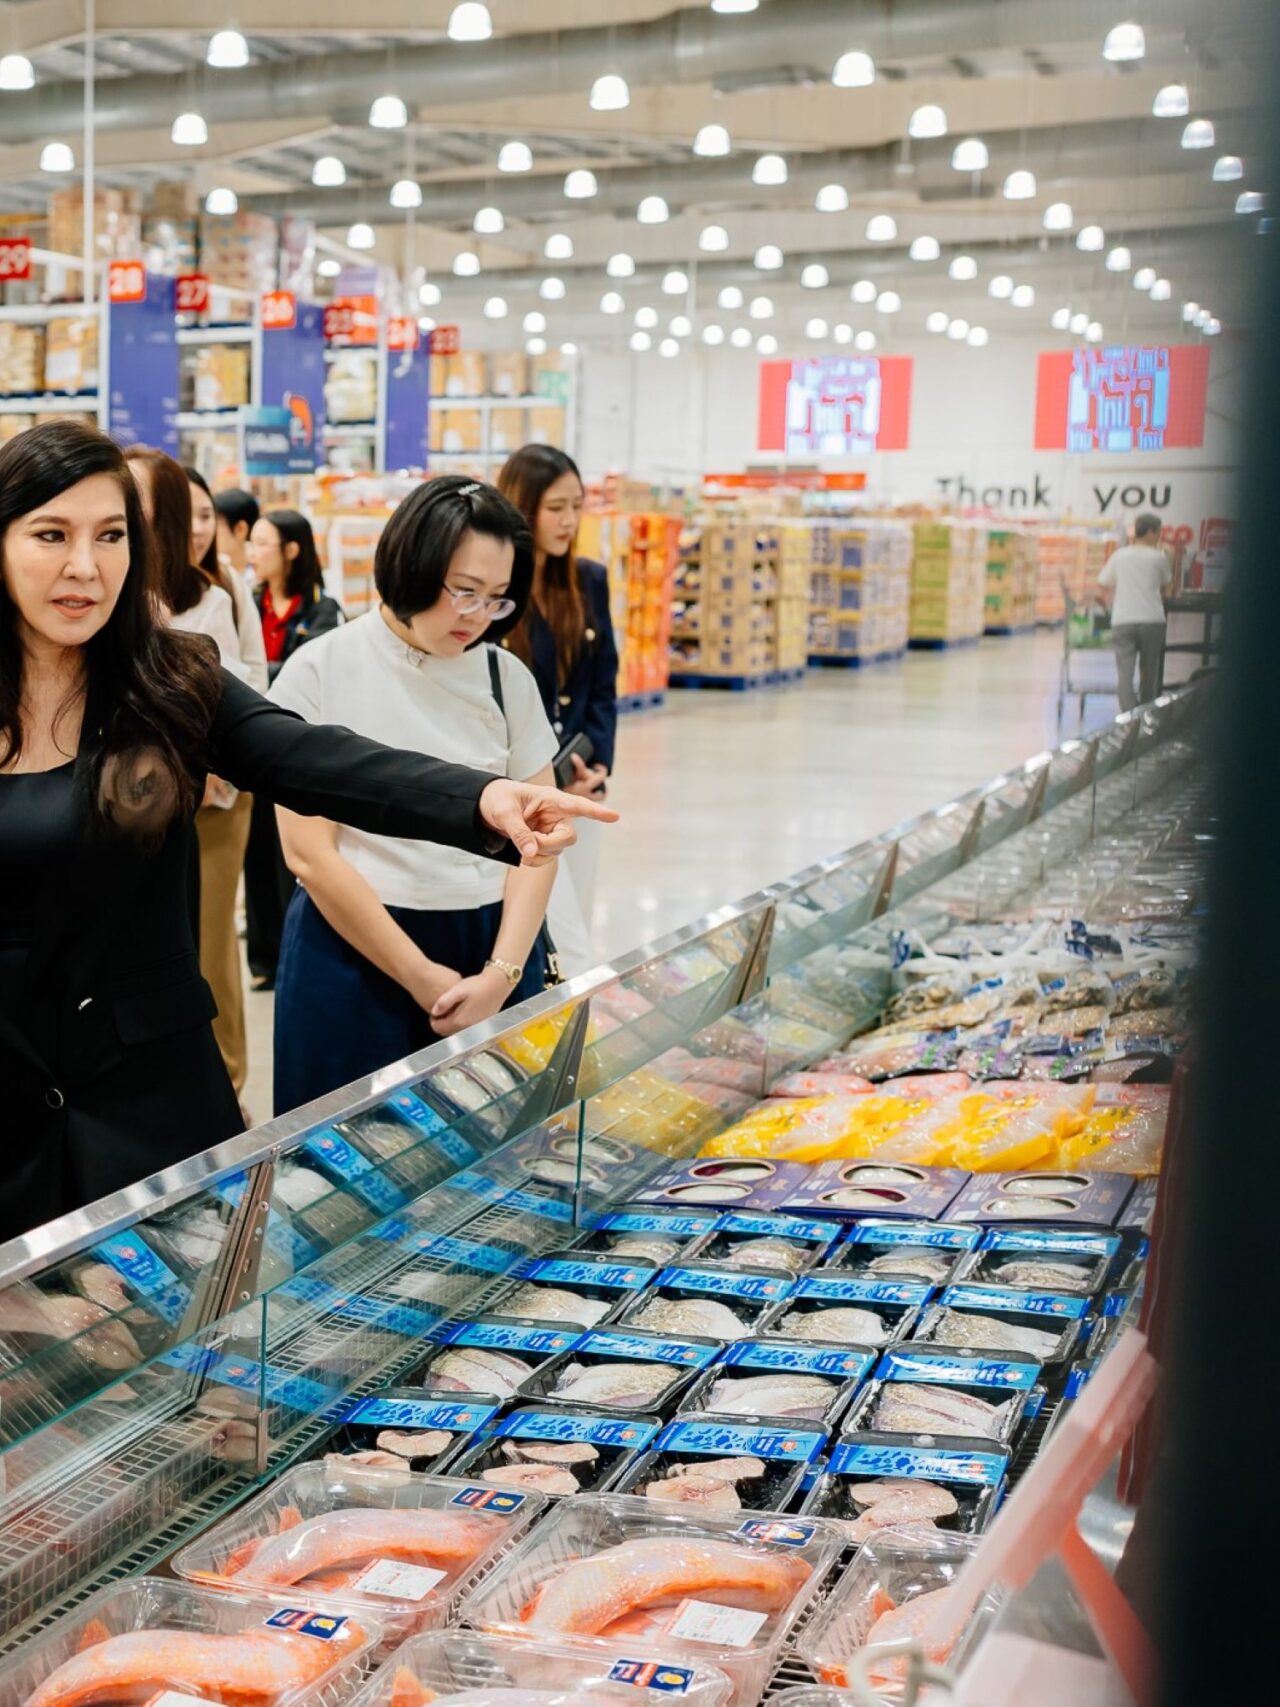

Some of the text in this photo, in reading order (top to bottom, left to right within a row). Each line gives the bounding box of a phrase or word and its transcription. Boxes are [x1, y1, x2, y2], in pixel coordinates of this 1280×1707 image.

[178, 279, 206, 306] 27
[936, 473, 1171, 513] Thank you
